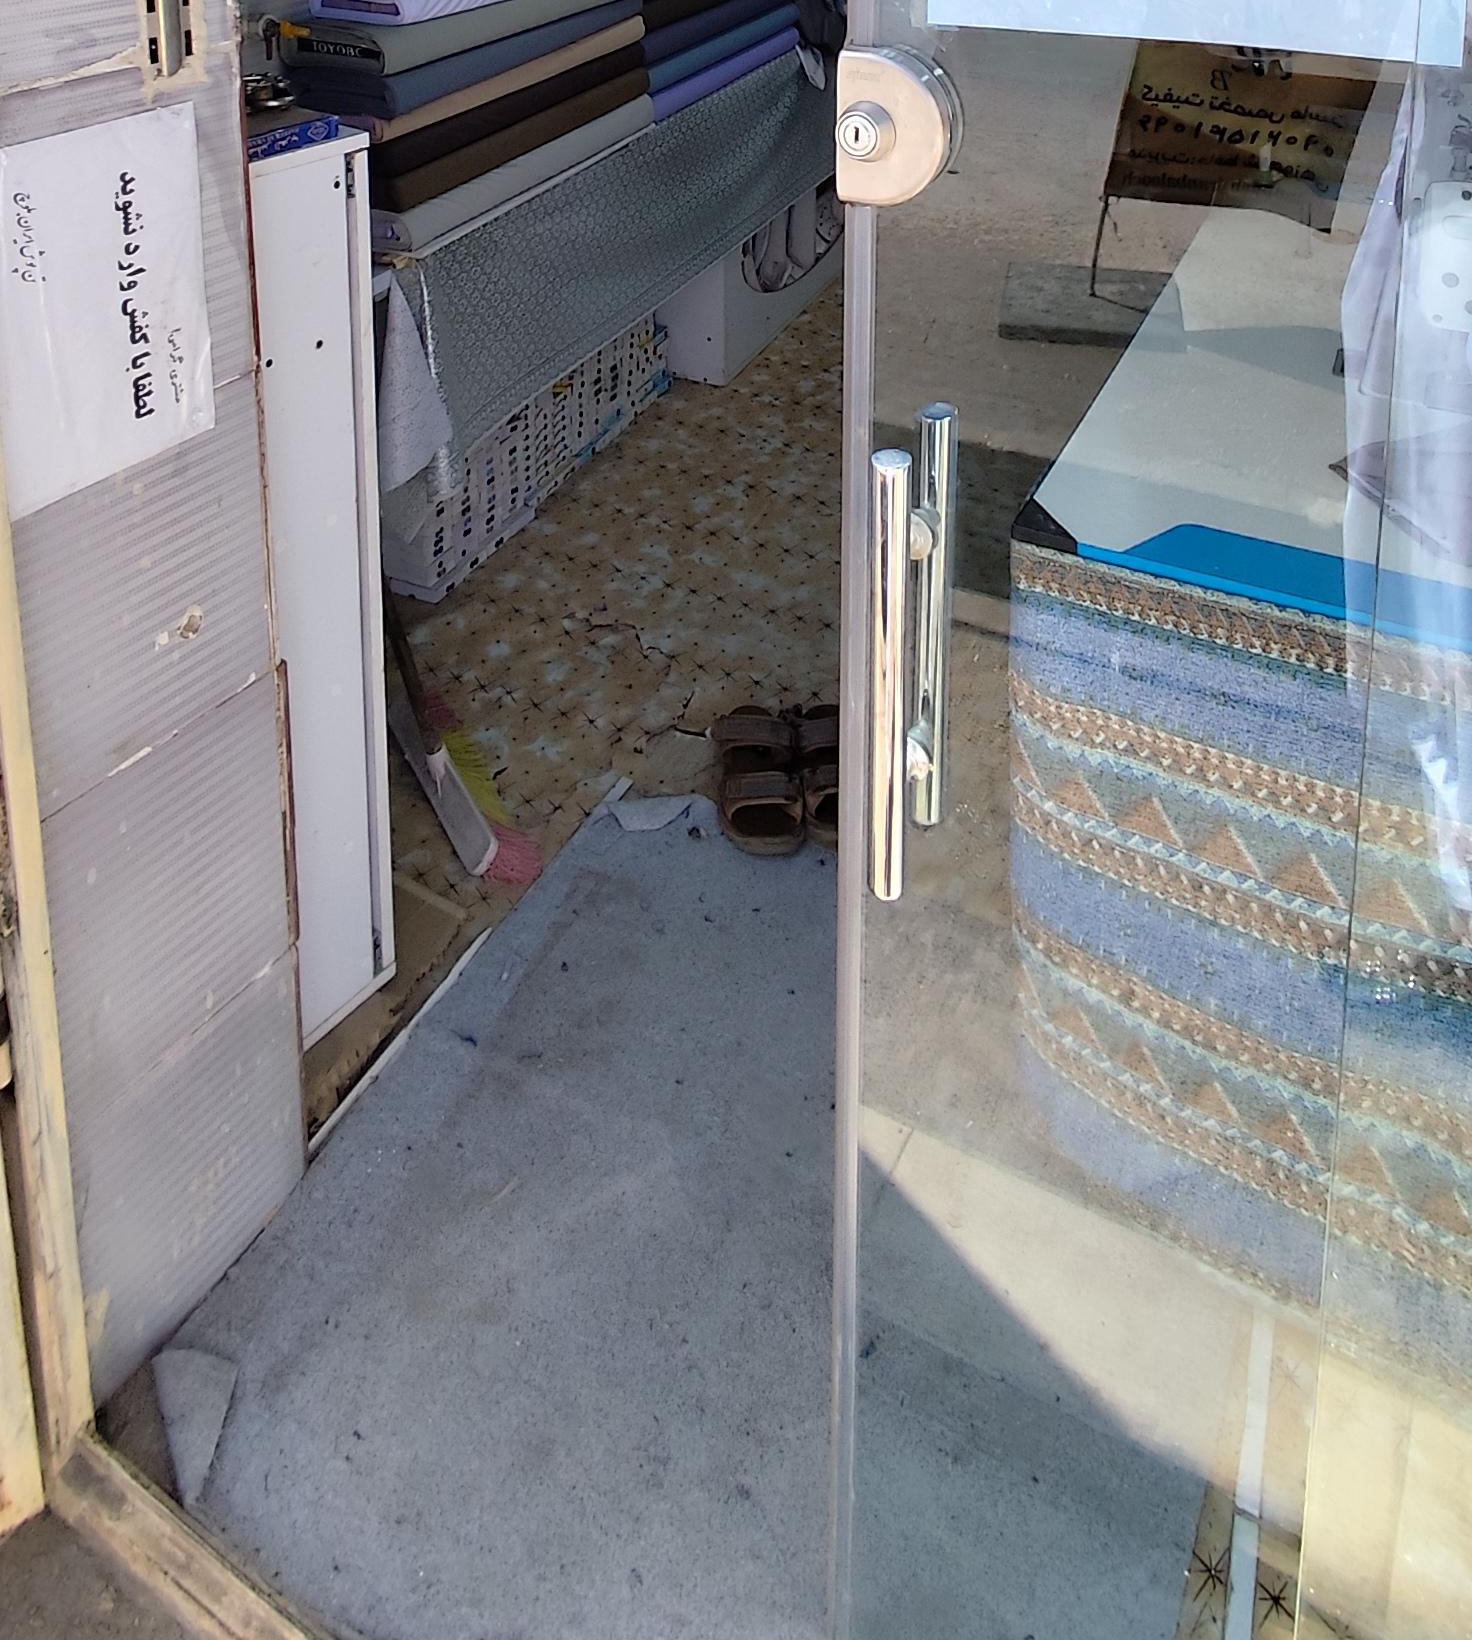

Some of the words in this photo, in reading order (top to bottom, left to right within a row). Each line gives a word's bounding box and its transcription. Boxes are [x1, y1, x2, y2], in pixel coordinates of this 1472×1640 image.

[113, 171, 145, 236] نشوید
[117, 242, 148, 292] وارد
[120, 297, 151, 346] کفش
[124, 350, 153, 373] با
[132, 371, 156, 420] لطفا
